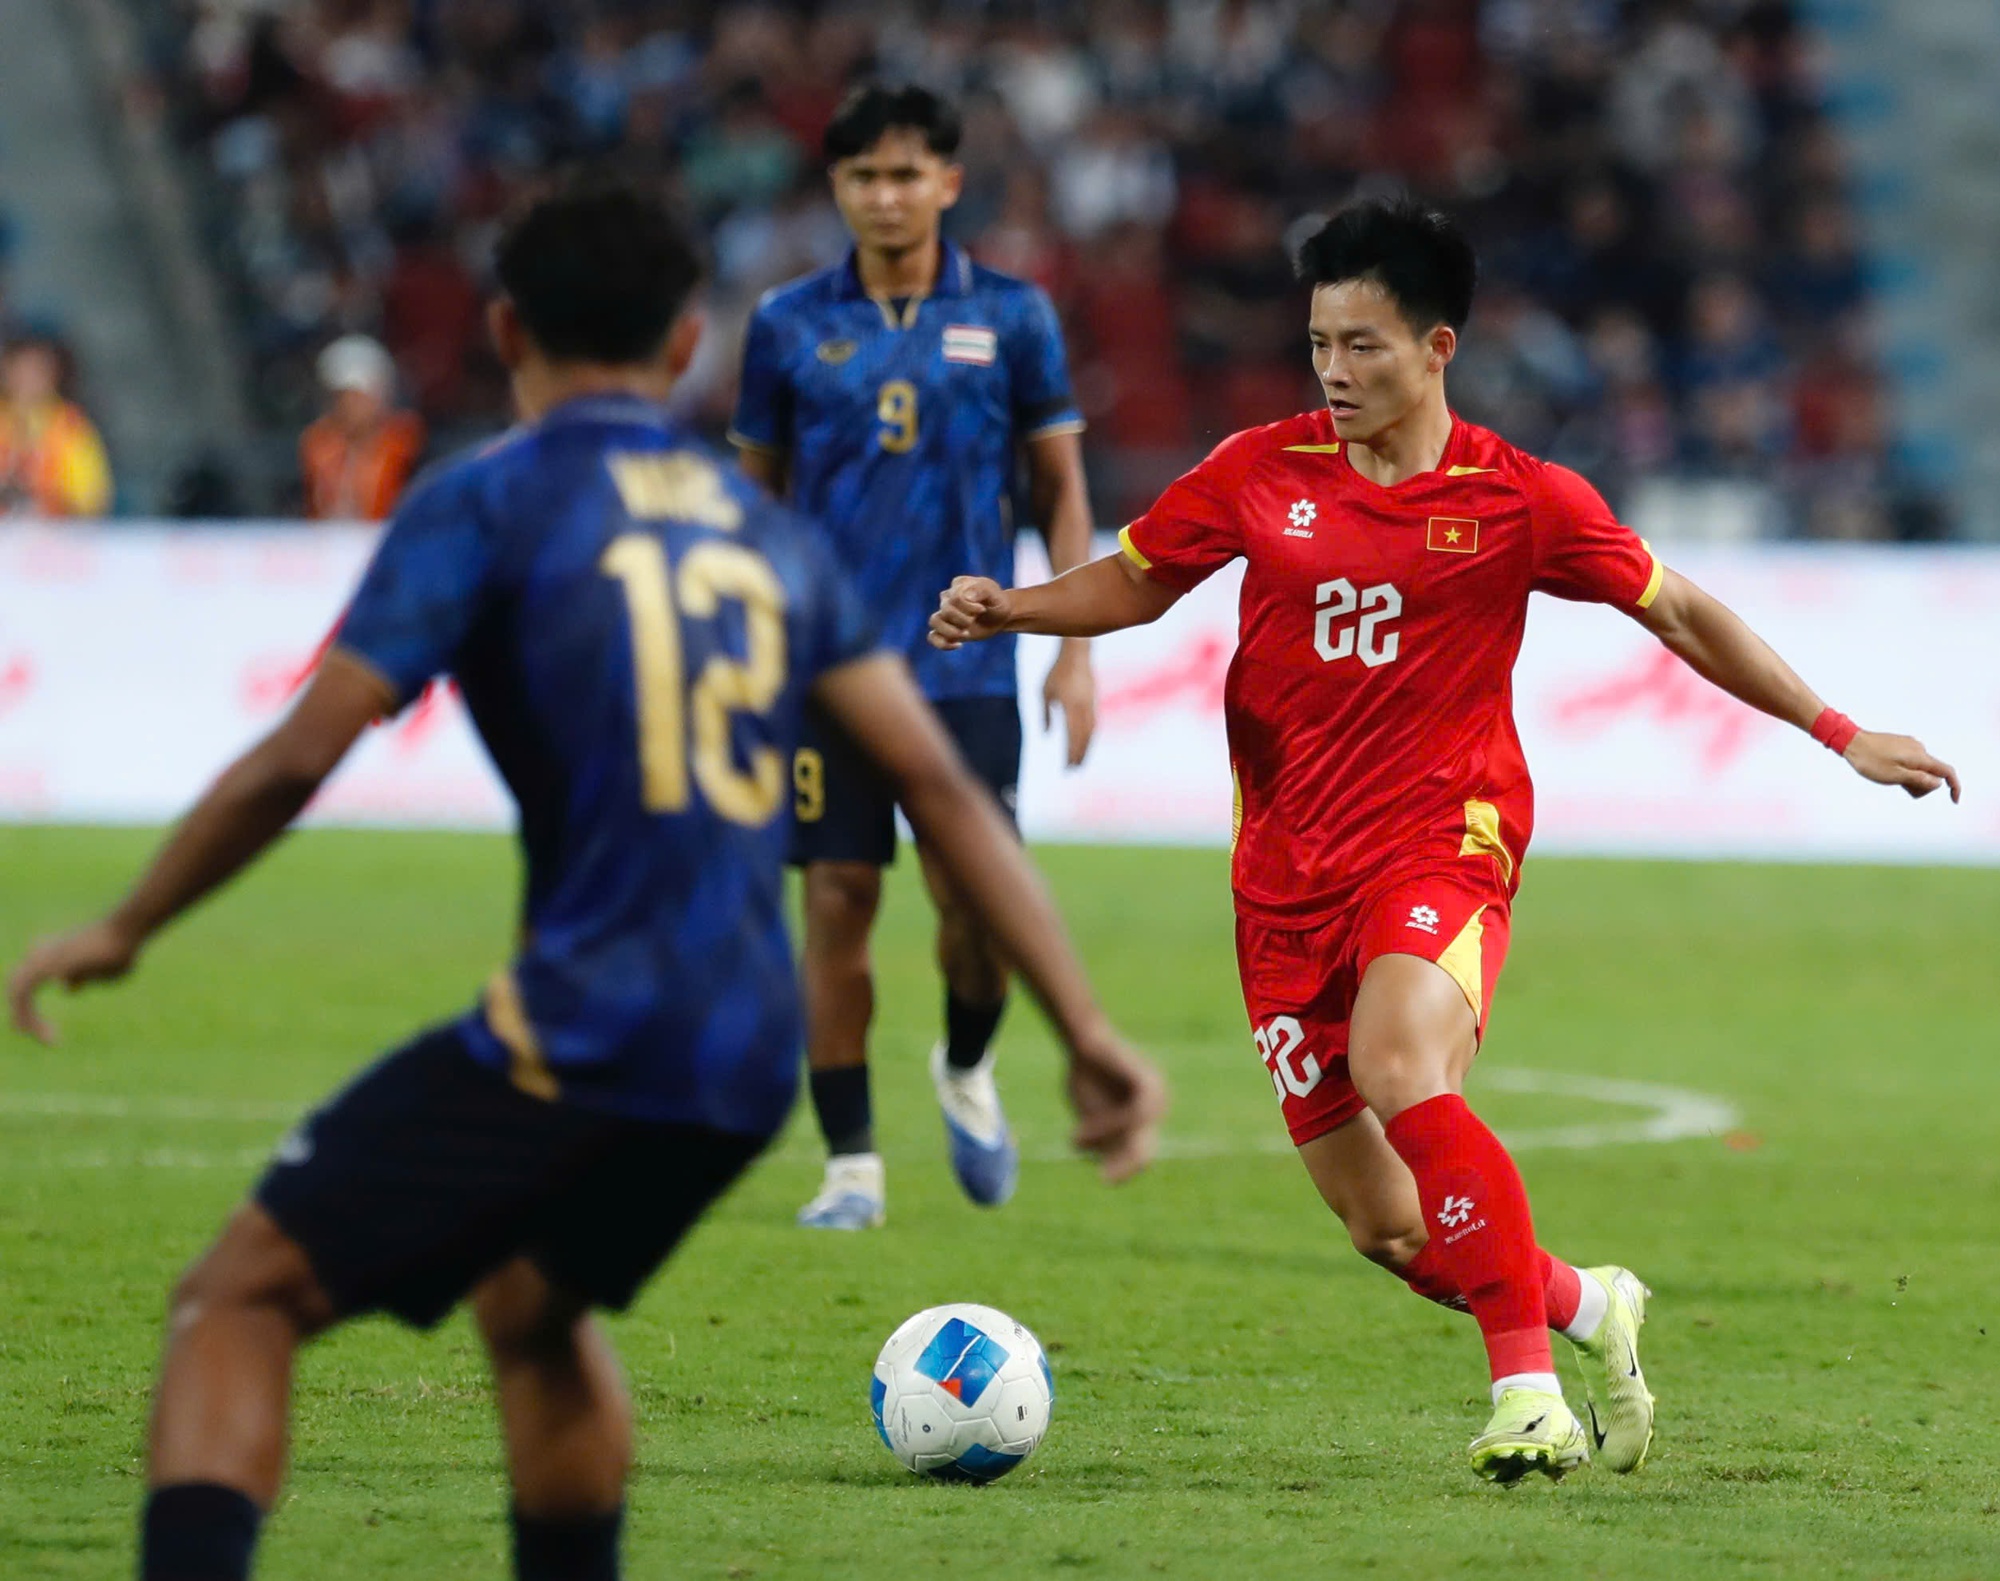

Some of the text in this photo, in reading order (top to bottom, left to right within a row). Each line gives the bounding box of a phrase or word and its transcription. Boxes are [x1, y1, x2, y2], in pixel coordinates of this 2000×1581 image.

[878, 379, 919, 454] 9
[1313, 577, 1403, 668] 22
[602, 534, 788, 828] 12
[793, 747, 825, 823] 9
